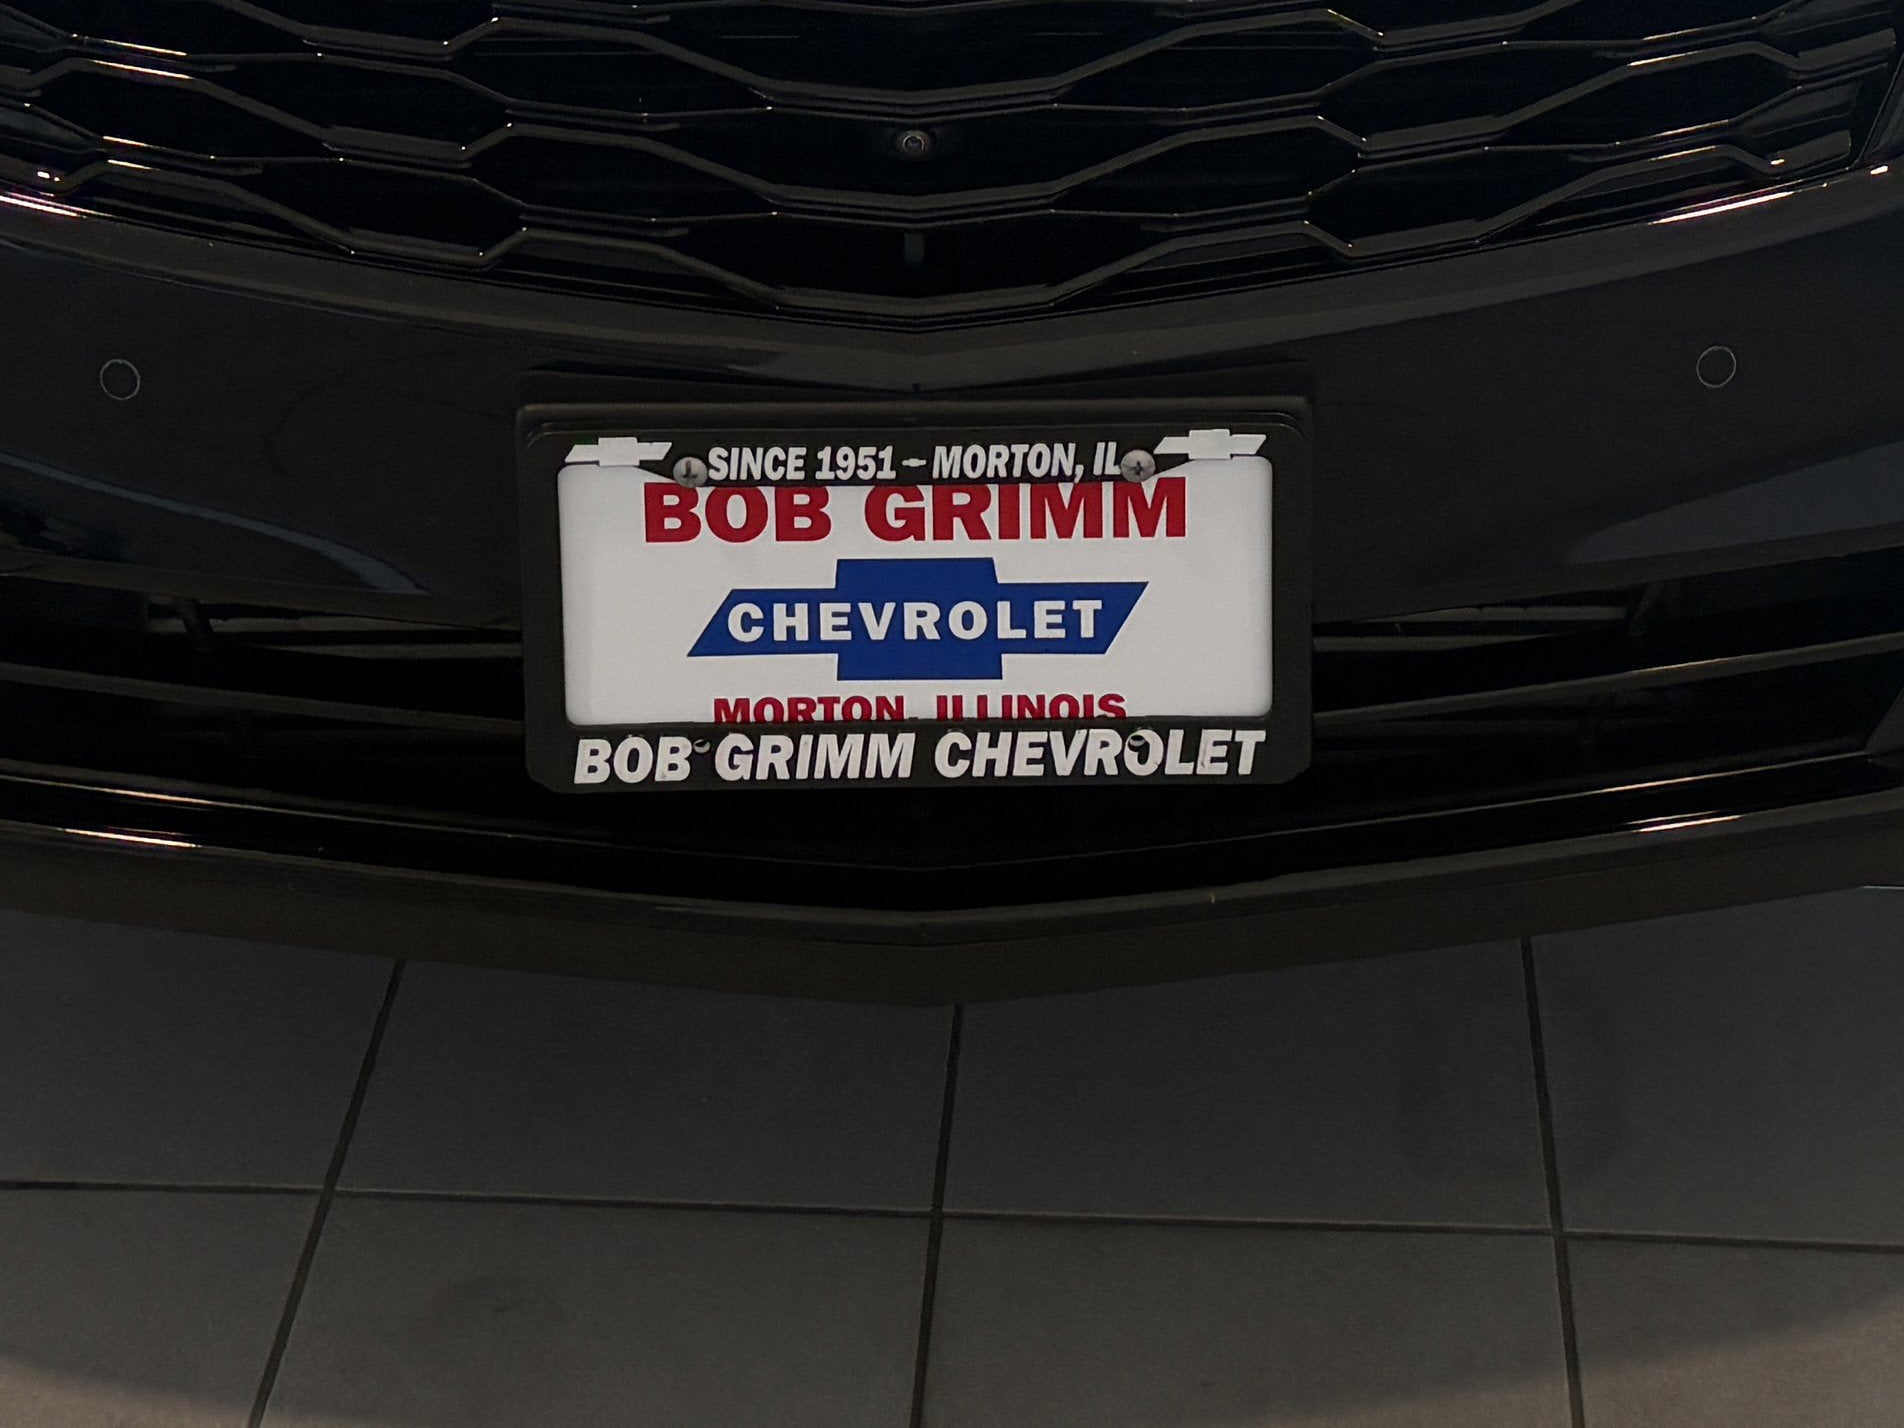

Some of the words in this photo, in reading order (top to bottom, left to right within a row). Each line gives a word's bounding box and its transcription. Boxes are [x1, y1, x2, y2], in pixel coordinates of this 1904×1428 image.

[707, 447, 806, 481] SINCE
[814, 446, 896, 480] 1951
[932, 442, 1084, 483] MORTON,
[1092, 442, 1121, 475] IL
[644, 481, 831, 543] BOB
[864, 476, 1186, 542] GRIMM
[727, 600, 1102, 643] CHEVROLET
[574, 735, 693, 784] BOB
[714, 732, 916, 781] GRIMM
[934, 728, 1267, 778] CHEVROLET
